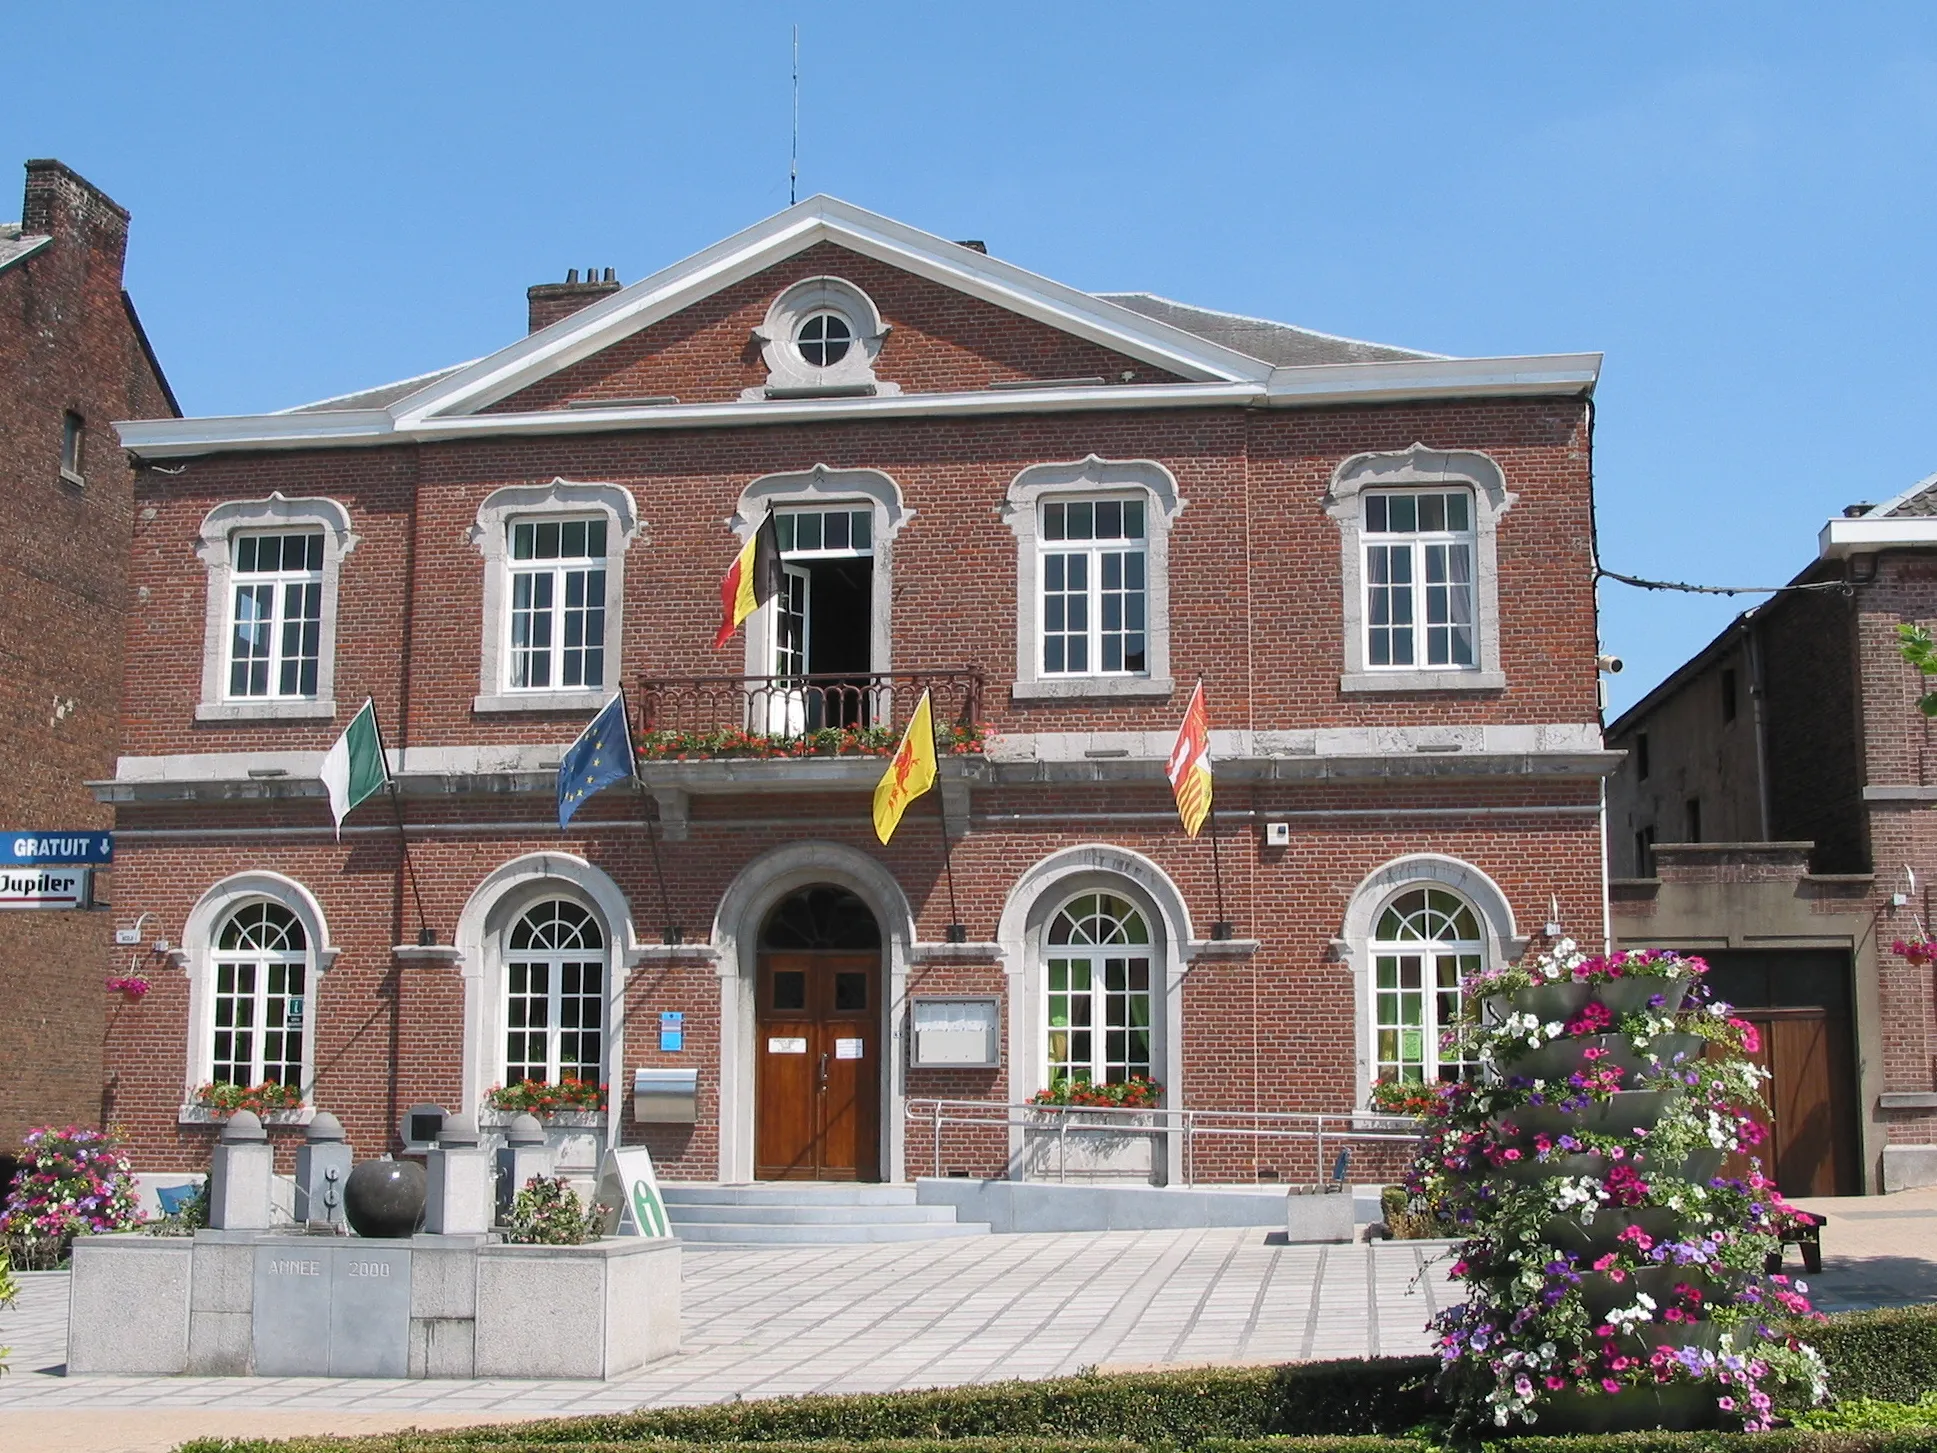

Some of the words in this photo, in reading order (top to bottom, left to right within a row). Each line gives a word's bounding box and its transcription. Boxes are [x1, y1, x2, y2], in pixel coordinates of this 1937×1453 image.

[14, 839, 90, 857] GRATUIT
[0, 874, 75, 896] Jupiler
[269, 1260, 320, 1276] ANNEE
[349, 1262, 390, 1277] 2000
